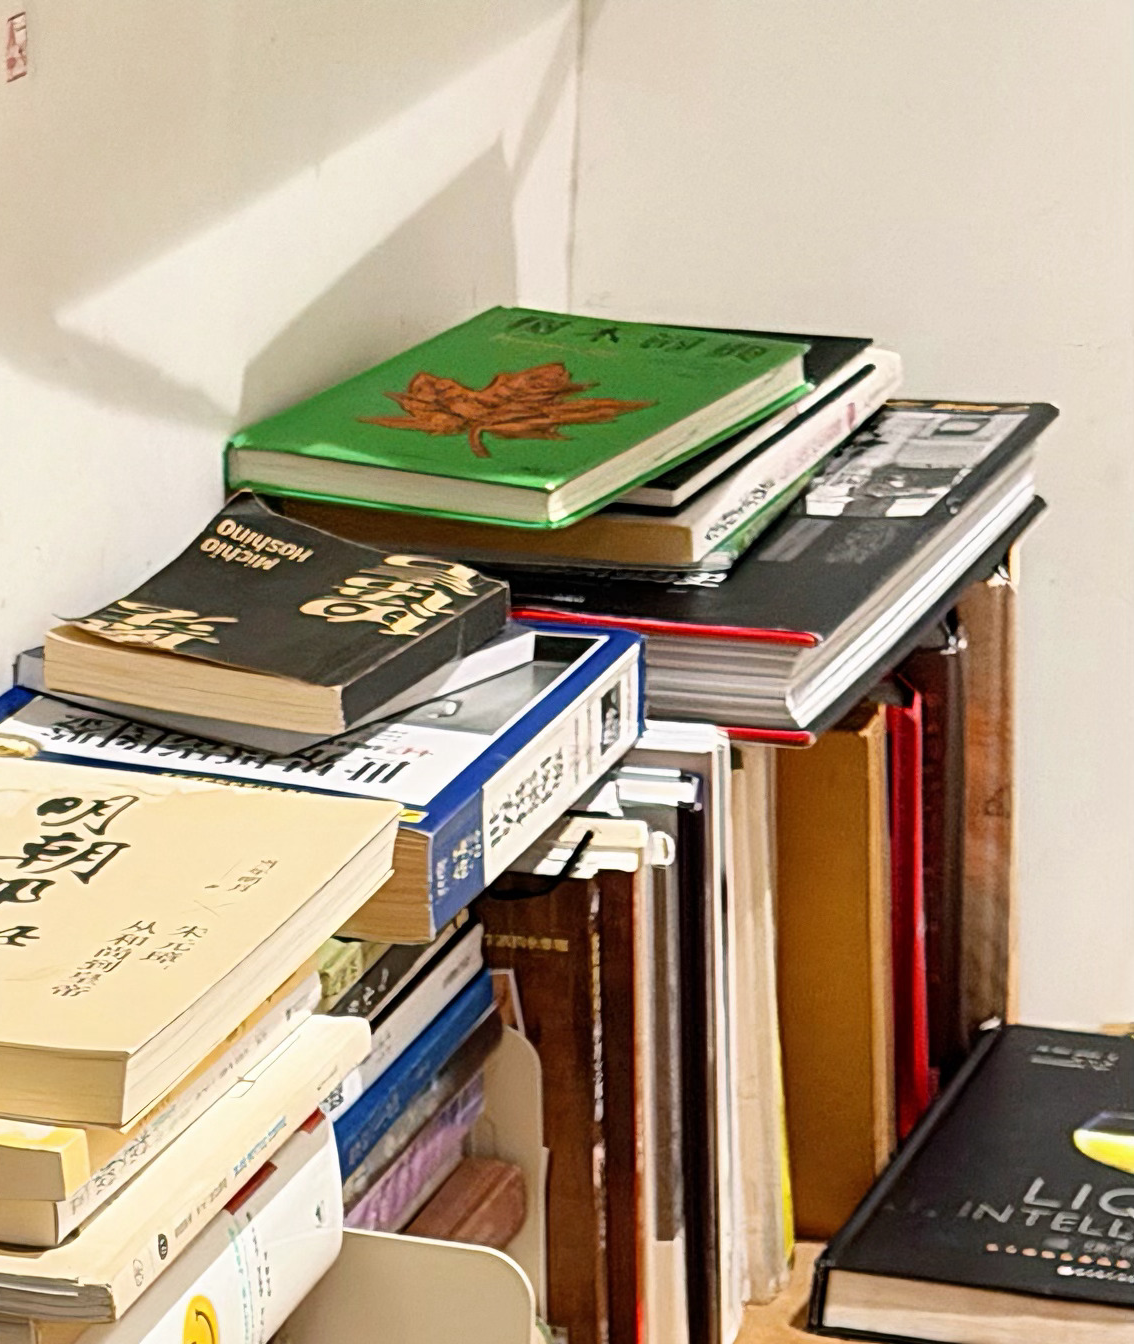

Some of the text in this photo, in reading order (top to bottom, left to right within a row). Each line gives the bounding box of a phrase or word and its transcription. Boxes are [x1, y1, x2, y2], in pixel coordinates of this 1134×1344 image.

[199, 536, 281, 571] Michio
[215, 518, 314, 564] Hoshino
[51, 919, 157, 997] 从和尚到皇帝
